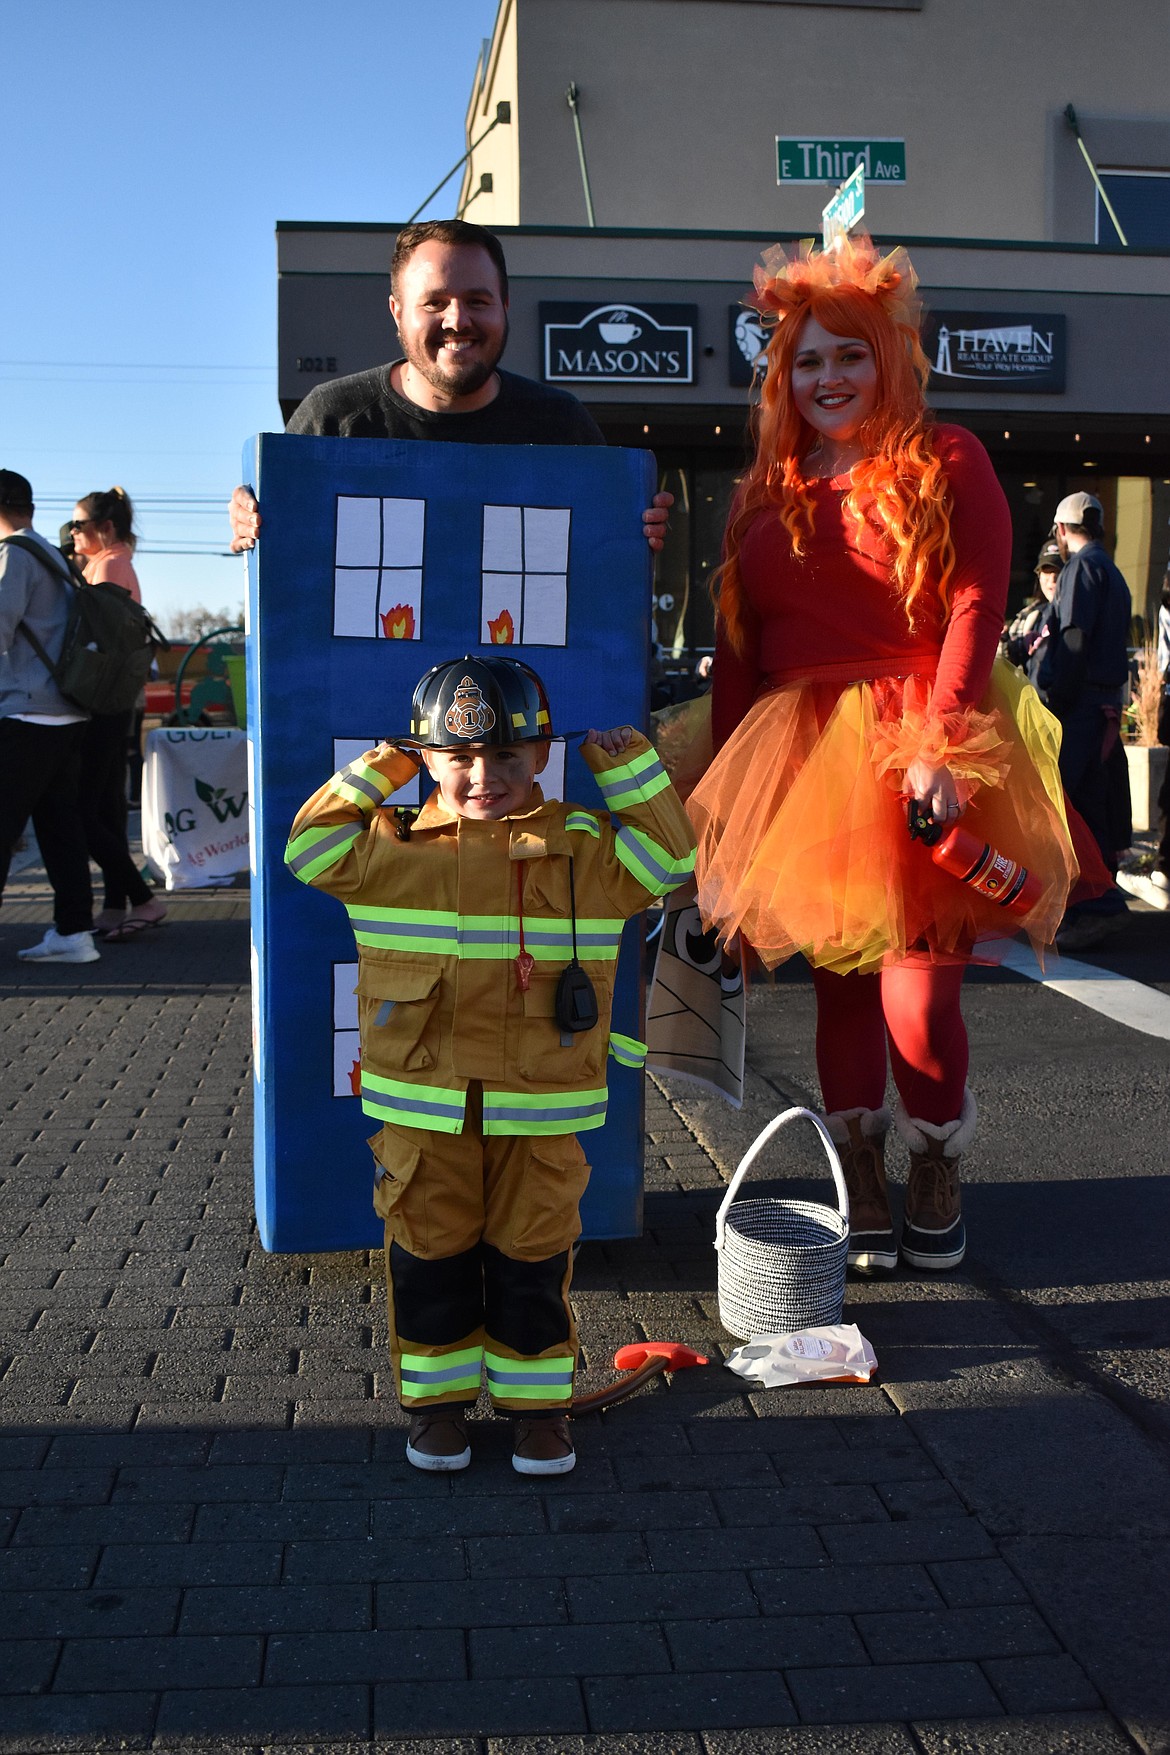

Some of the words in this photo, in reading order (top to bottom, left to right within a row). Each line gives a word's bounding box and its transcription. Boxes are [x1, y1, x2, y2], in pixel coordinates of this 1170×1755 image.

[782, 160, 792, 177] E
[798, 143, 871, 178] Third
[874, 161, 900, 178] Ave
[958, 329, 1054, 354] HAVEN
[558, 349, 681, 374] MASON'S
[957, 352, 980, 362] REAL
[983, 353, 1019, 363] ESTATE
[1020, 354, 1053, 364] GROUP
[465, 679, 470, 687] 1
[464, 710, 475, 727] 1
[994, 854, 1009, 873] FIRE
